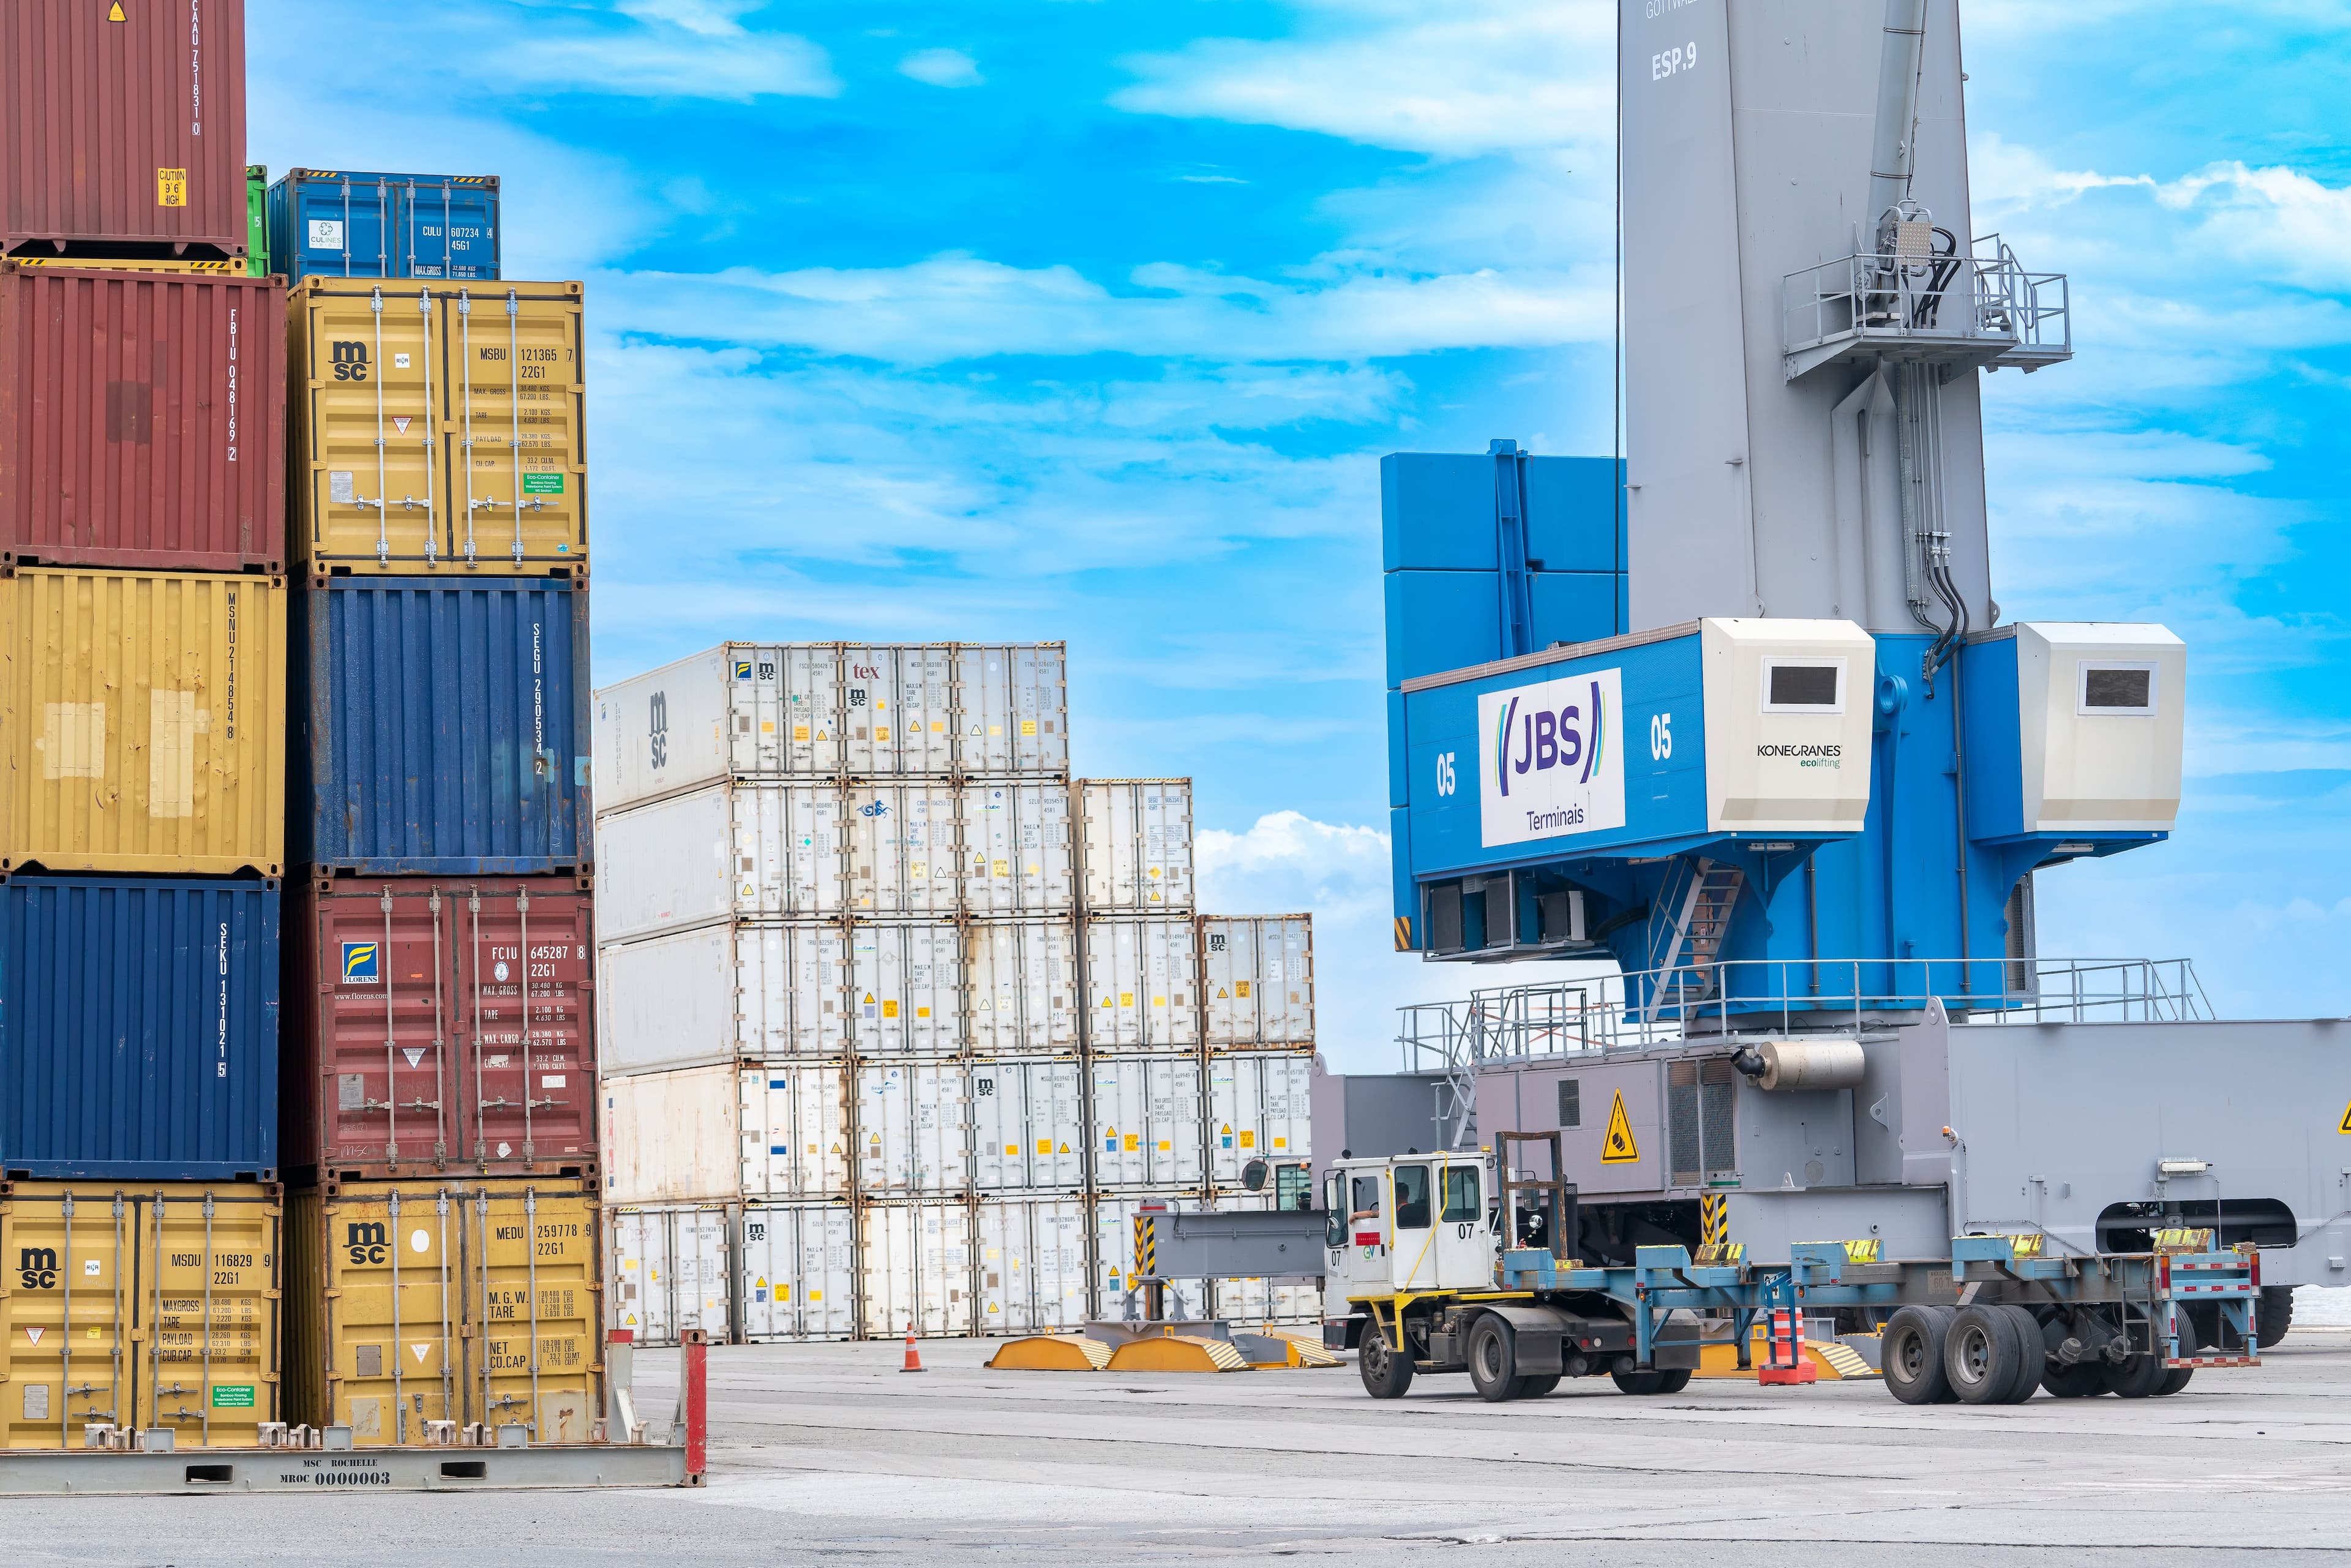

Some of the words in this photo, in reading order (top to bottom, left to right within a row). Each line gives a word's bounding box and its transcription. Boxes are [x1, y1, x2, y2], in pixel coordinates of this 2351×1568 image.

[1652, 42, 1697, 81] ESP.9
[193, 123, 200, 135] 0
[160, 170, 185, 181] CAUTION
[165, 195, 179, 205] HIGH
[255, 217, 261, 227] 5
[423, 226, 441, 236] CULU
[451, 227, 479, 238] 607234
[487, 228, 493, 238] 4
[452, 241, 470, 250] 45G1
[480, 348, 506, 360] MSBU
[521, 348, 557, 361] 121365
[567, 349, 573, 361] 7
[522, 366, 545, 378] 22G1
[229, 448, 236, 460] 2
[853, 662, 880, 679] tex
[227, 726, 234, 739] 8
[1651, 713, 1672, 761] 05
[1515, 706, 1582, 775] JBS
[1757, 745, 1842, 757] KONECRANES
[536, 760, 543, 775] 2
[1800, 757, 1841, 770] ecolifting
[1437, 752, 1456, 797] 05
[1526, 803, 1584, 831] Terminais
[492, 947, 517, 959] FCIU
[531, 946, 568, 959] 645287
[578, 946, 585, 959] 8
[531, 964, 555, 977] 22G1
[483, 986, 497, 996] MAX.
[499, 985, 517, 995] GROSS
[484, 1010, 498, 1019] TARE
[484, 1034, 499, 1044] MAX.
[500, 1034, 519, 1044] CARGO
[219, 1063, 226, 1076] 5
[497, 1226, 523, 1240] MEDU
[538, 1224, 577, 1238] 259778
[586, 1224, 591, 1236] 9
[1458, 1223, 1474, 1239] 07
[538, 1242, 563, 1255] 22G1
[172, 1254, 201, 1267] MSDU
[215, 1254, 252, 1267] 116829
[264, 1254, 271, 1267] 9
[1332, 1251, 1341, 1267] 07
[214, 1272, 238, 1284] 22G1
[163, 1300, 199, 1312] MAXGROSS
[490, 1306, 514, 1318] TARE
[164, 1316, 180, 1329] TARE
[162, 1333, 192, 1345] PAYLOAD
[490, 1341, 508, 1354] NET
[162, 1349, 193, 1362] CUB.CAP.
[490, 1356, 526, 1368] CU.CAP
[303, 1459, 321, 1468] MSC
[331, 1458, 378, 1467] ROCHELLE
[280, 1474, 310, 1484] MROC
[315, 1471, 390, 1486] 0000003
